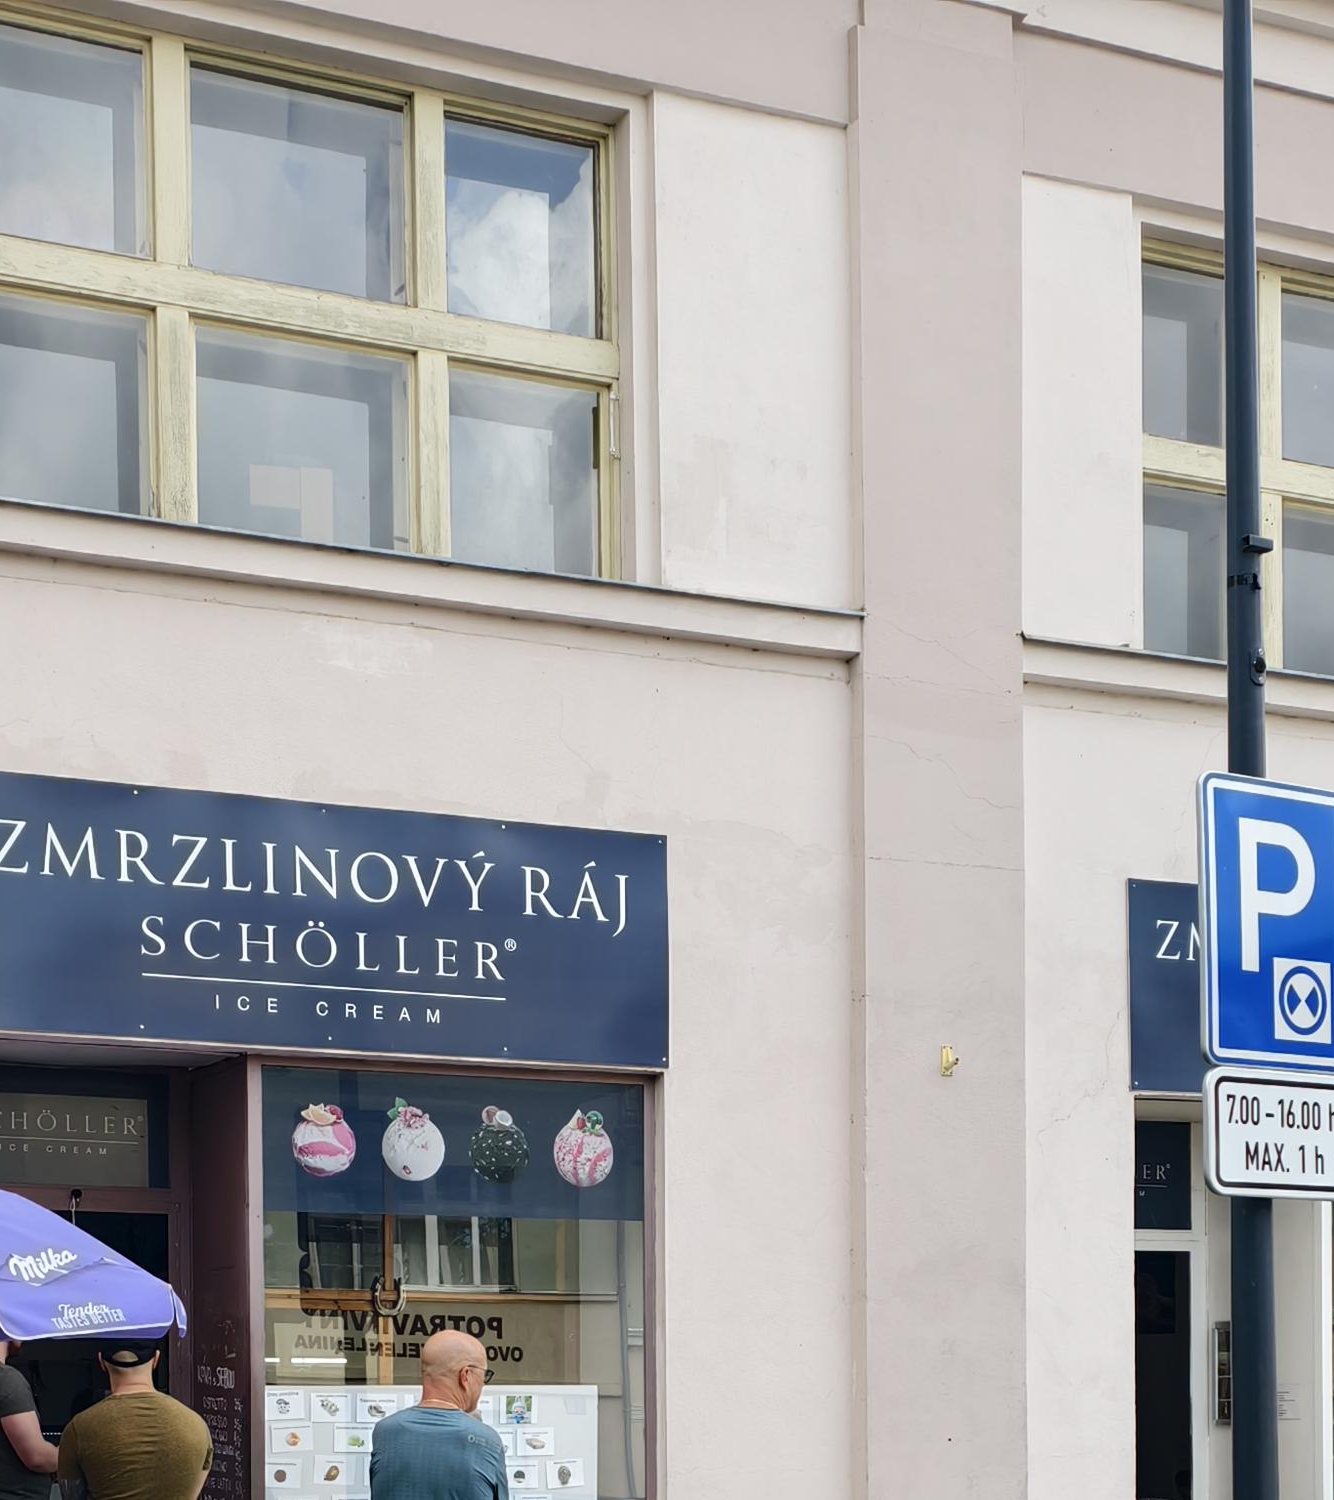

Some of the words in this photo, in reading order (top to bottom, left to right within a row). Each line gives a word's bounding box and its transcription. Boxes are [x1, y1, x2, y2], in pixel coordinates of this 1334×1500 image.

[521, 861, 630, 937] RÁJ
[1238, 817, 1316, 973] P
[215, 995, 279, 1014] ICE
[316, 1001, 442, 1025] CREAM
[0, 1143, 29, 1152] ICE
[46, 1145, 107, 1155] CREAM
[1245, 1141, 1290, 1173] MAX.
[1298, 1145, 1306, 1174] 1
[1314, 1145, 1325, 1175] h
[9, 1248, 78, 1282] Milka
[59, 1302, 111, 1319] Tender
